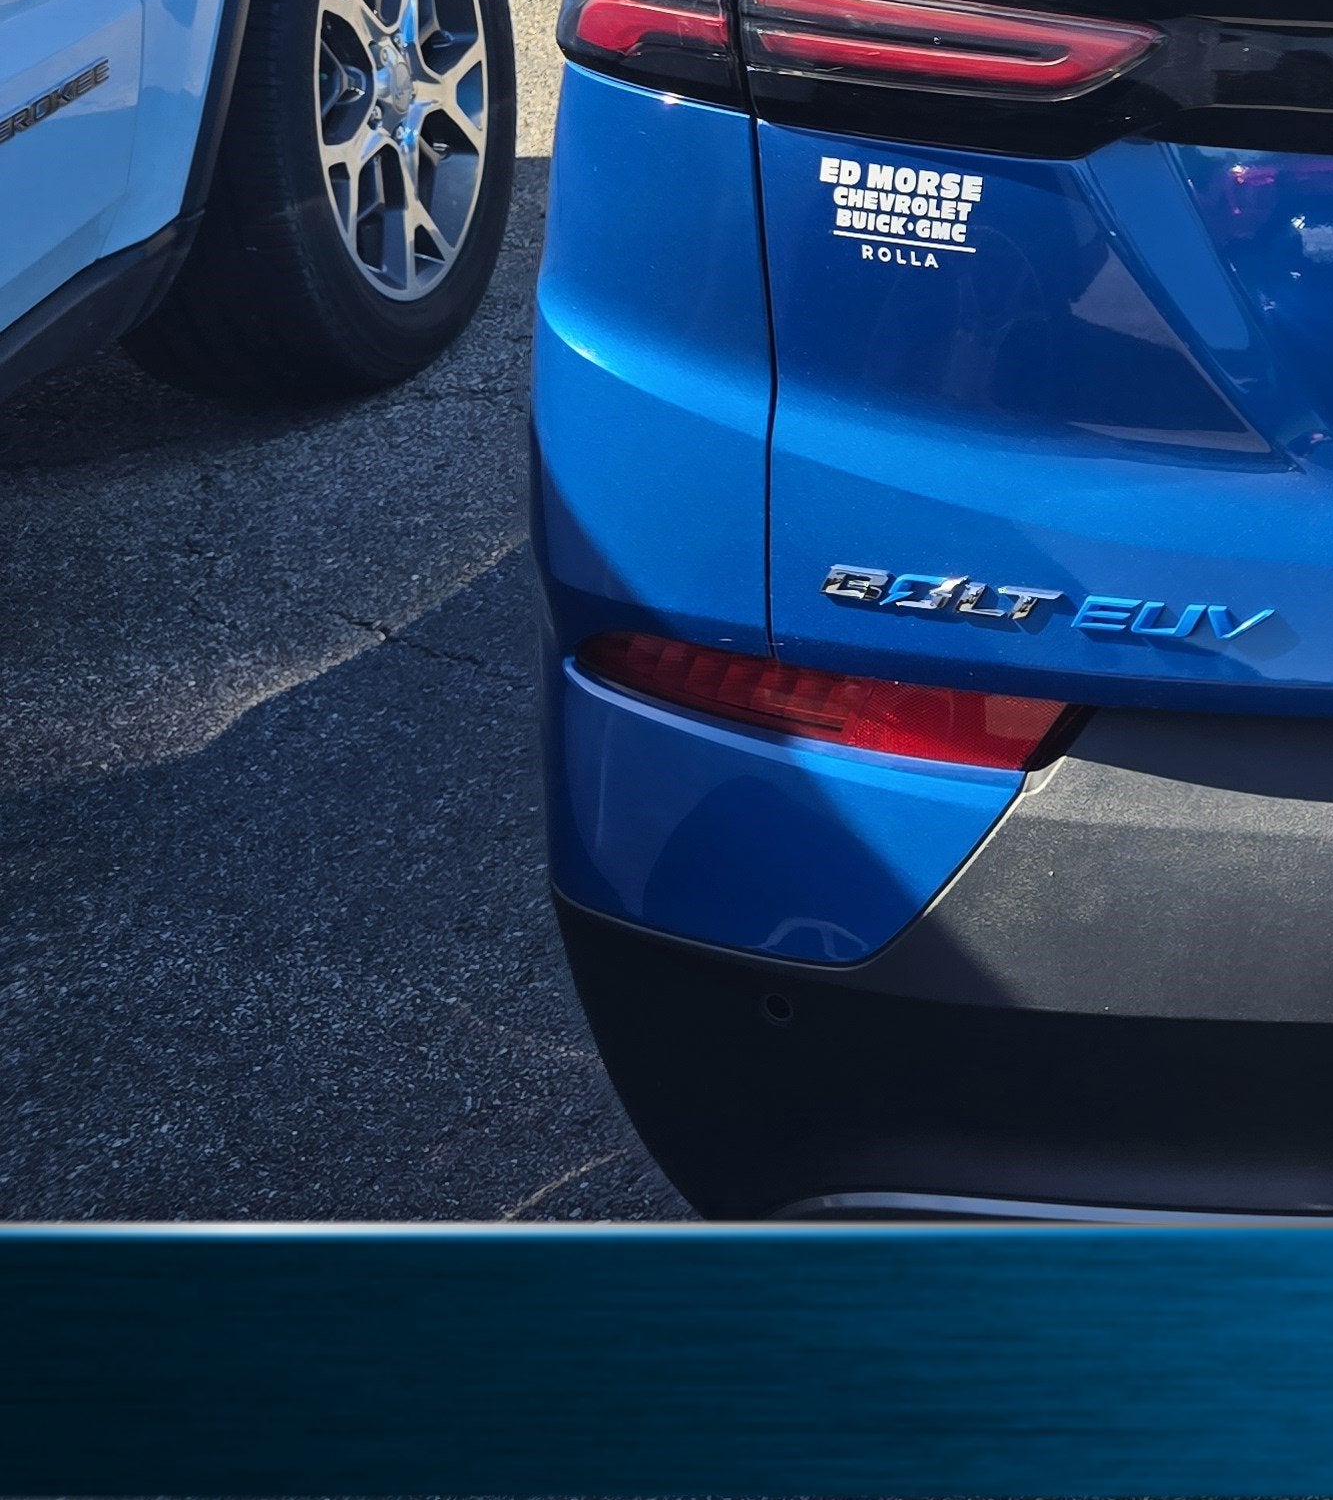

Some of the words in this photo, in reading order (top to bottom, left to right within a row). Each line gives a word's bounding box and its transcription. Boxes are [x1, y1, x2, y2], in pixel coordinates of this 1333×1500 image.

[819, 156, 862, 186] ED
[866, 163, 983, 202] MORSE
[832, 185, 973, 221] CHEVROLET
[861, 244, 939, 269] ROLLA
[819, 563, 1064, 620] BOLT
[1071, 594, 1275, 641] EUV
